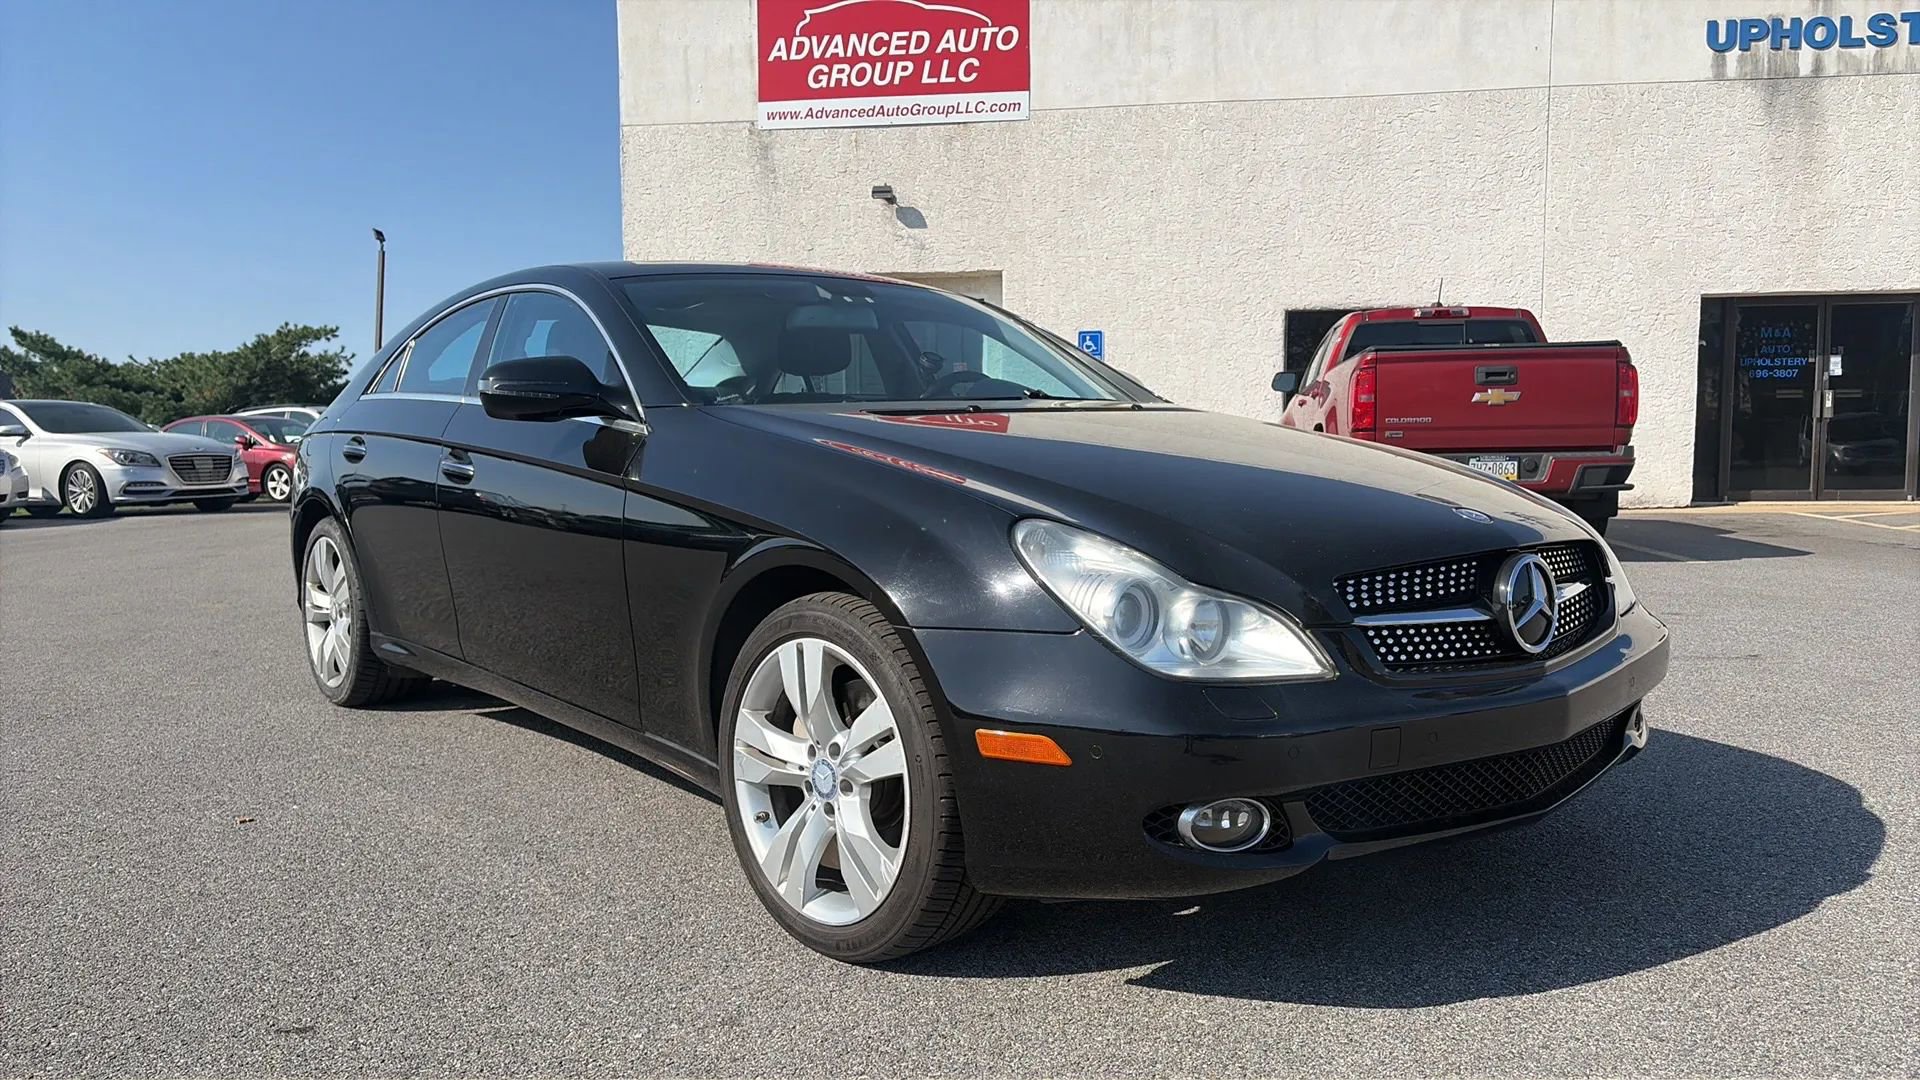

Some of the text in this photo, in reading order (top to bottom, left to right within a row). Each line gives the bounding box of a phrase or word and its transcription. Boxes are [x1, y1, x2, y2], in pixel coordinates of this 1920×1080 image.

[1706, 11, 1920, 53] UPHOLST
[767, 25, 1020, 62] ADVANCED AUTO
[806, 57, 981, 89] GROUP LLC
[766, 100, 1022, 121] www.AdvancedAutoGroupLLC.com
[1760, 344, 1791, 354] AUTO
[1740, 357, 1808, 367] UPHOLSTERY
[1749, 369, 1799, 378] 696-3807
